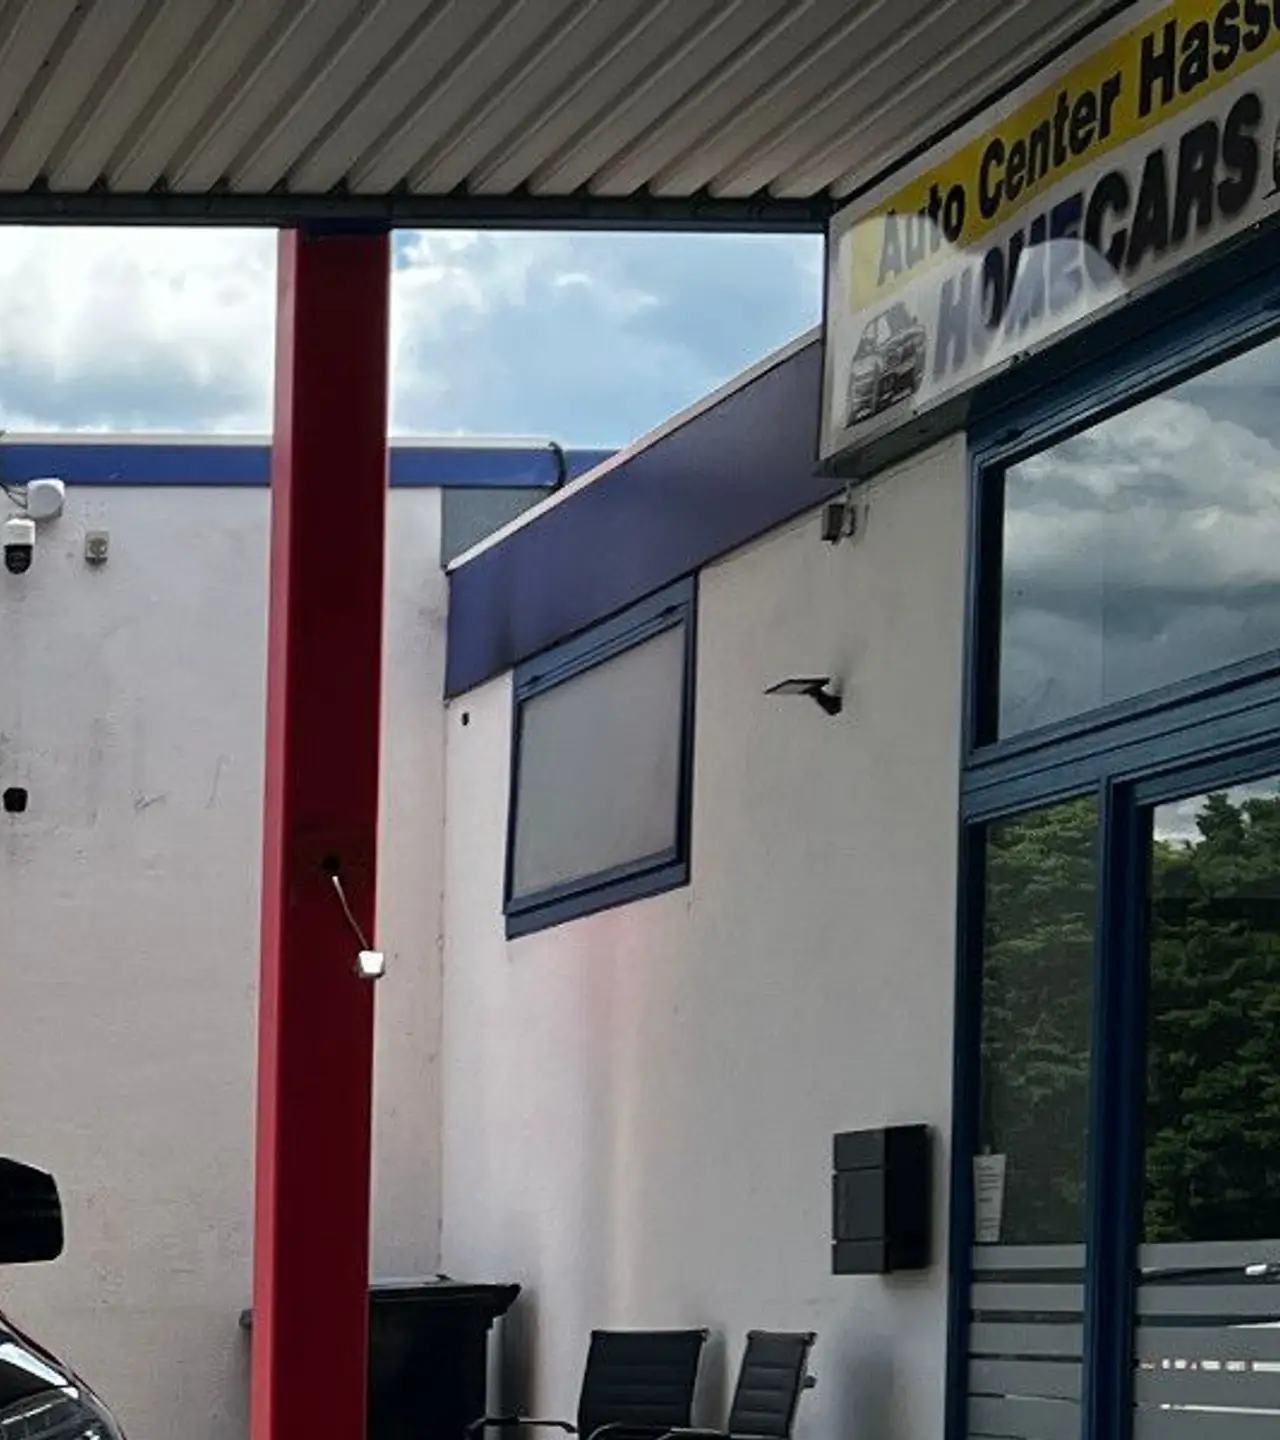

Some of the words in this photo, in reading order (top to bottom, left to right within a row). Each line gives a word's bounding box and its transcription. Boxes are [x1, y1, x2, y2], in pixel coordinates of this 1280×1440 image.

[876, 183, 966, 287] Auto
[978, 71, 1122, 220] Center
[1138, 0, 1280, 118] Hass
